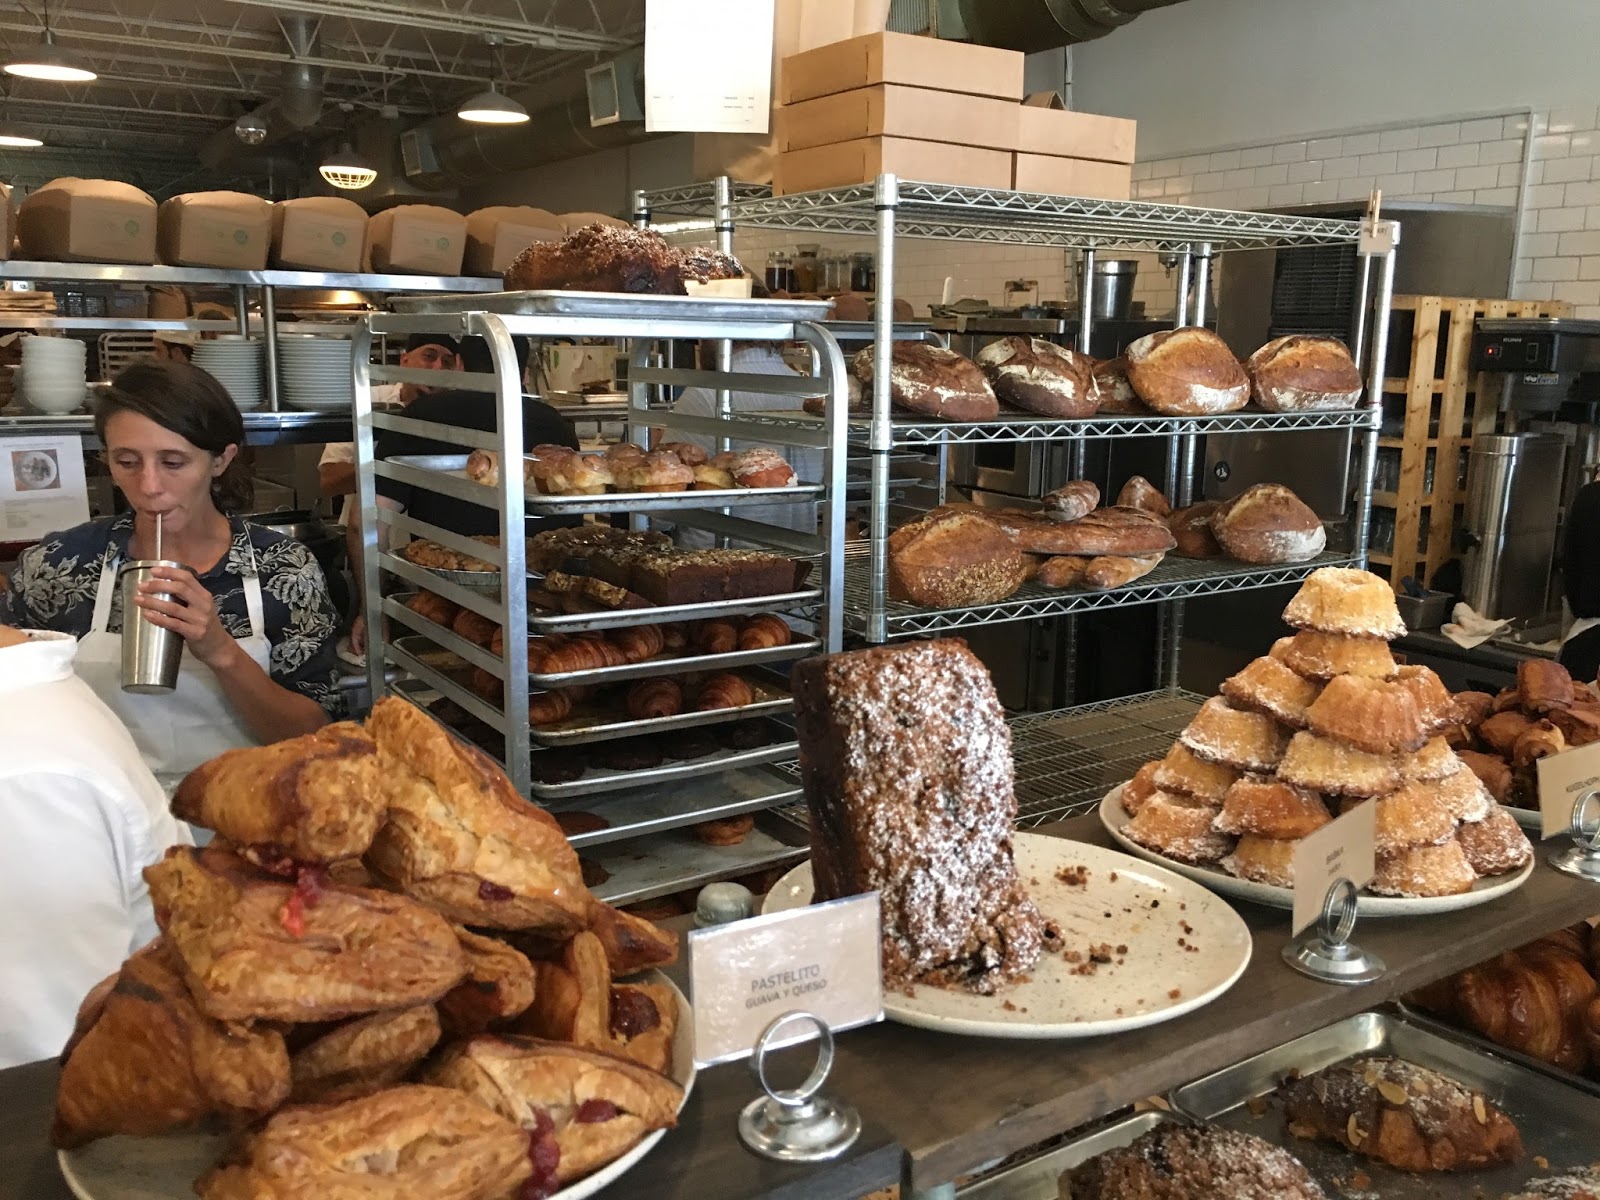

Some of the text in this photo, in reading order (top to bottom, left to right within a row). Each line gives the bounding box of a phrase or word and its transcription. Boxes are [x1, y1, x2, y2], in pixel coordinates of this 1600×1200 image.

[751, 964, 820, 992] PASTELITO
[745, 979, 828, 1010] GUAVA Y QUESO
